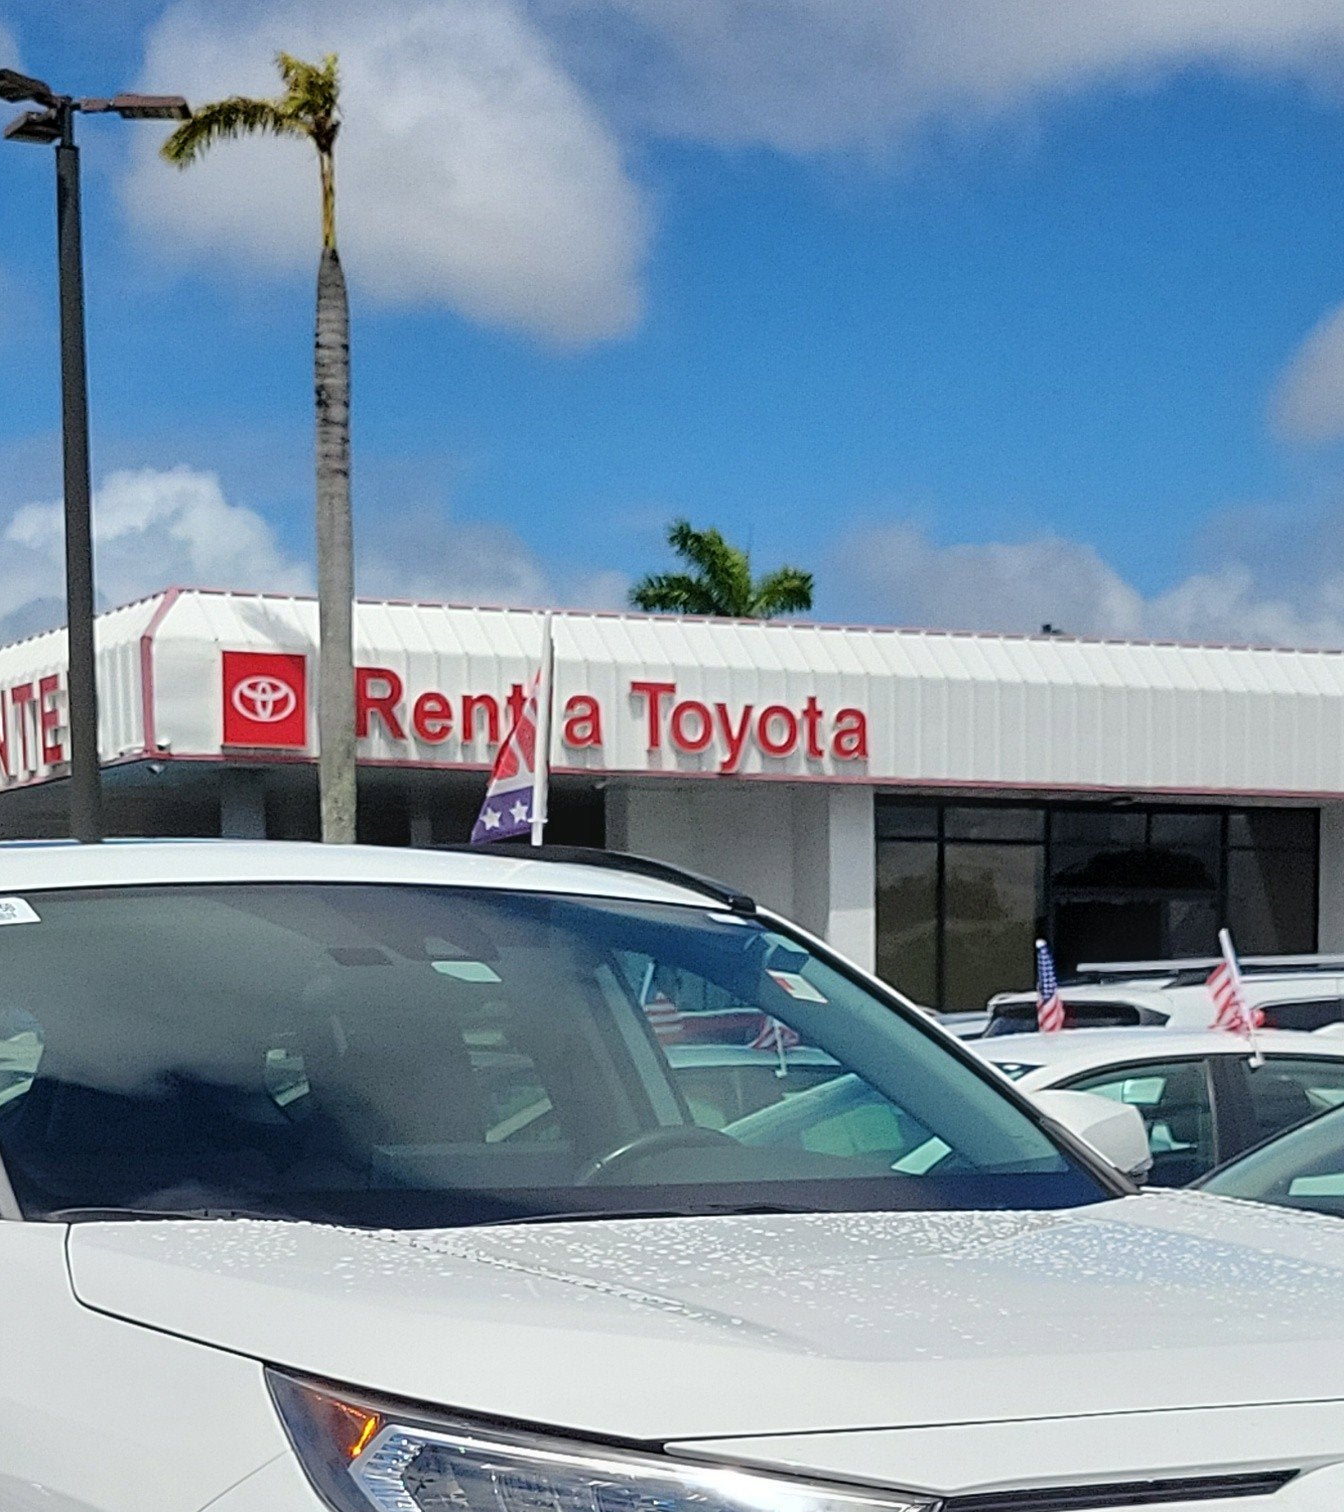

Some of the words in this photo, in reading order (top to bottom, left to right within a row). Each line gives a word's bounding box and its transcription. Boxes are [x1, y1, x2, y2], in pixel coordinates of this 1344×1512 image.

[354, 667, 527, 744] Rent
[564, 695, 603, 747] a
[630, 681, 869, 773] Toyota
